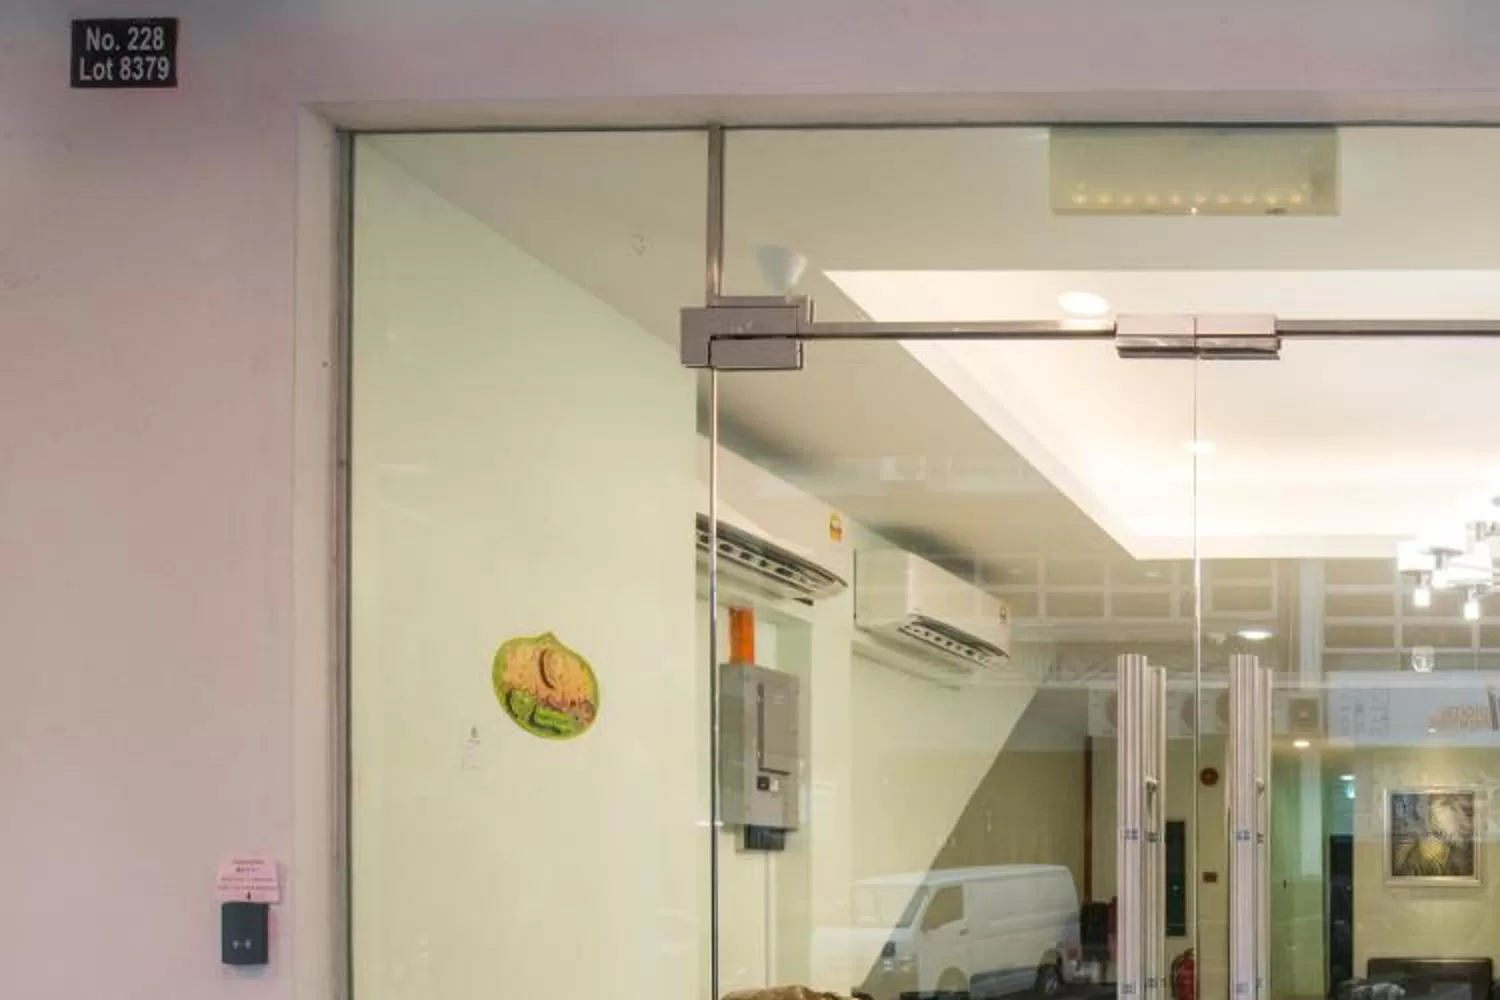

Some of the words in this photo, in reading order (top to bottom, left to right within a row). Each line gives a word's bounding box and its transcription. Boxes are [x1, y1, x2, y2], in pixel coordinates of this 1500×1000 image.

[85, 27, 121, 51] No.
[127, 26, 165, 51] 228
[80, 56, 114, 81] Lot
[120, 56, 170, 81] 8379
